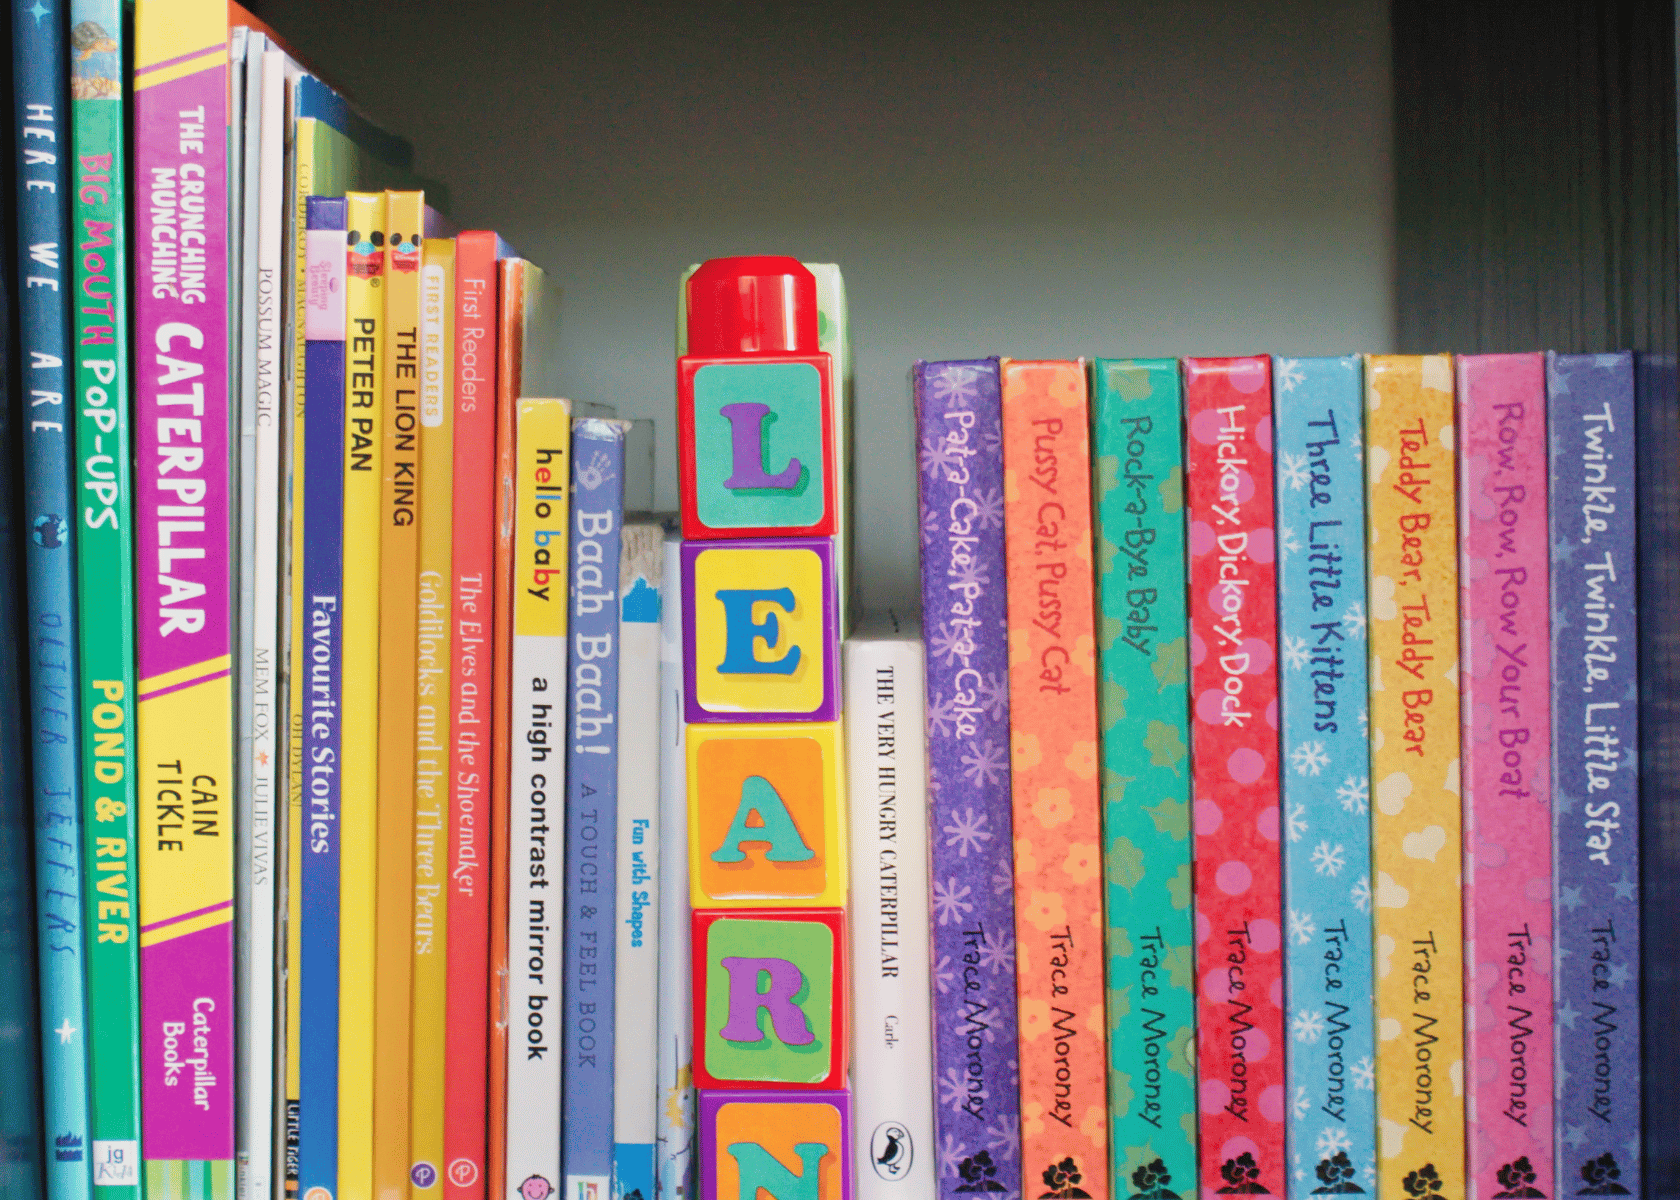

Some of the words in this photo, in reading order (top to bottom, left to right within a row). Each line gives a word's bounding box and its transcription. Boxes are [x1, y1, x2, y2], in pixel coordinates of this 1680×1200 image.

[24, 104, 56, 194] HERE
[179, 106, 205, 154] THE
[79, 152, 113, 206] BIG
[26, 241, 59, 292] WE
[151, 168, 179, 299] MUNCHING
[180, 163, 206, 304] CRUNCHING
[257, 268, 274, 350] POSSUM
[307, 265, 319, 306] Beauty
[317, 261, 333, 310] Sleeping
[425, 275, 441, 324] FIRST
[461, 279, 486, 319] First
[352, 318, 374, 408] PETER
[396, 327, 417, 378] THE
[424, 330, 442, 417] READERS
[460, 327, 486, 412] Readers
[29, 351, 64, 433] ARE
[257, 359, 273, 427] MAGIC
[394, 389, 416, 452] LION
[350, 417, 373, 472] PAN
[1029, 418, 1064, 494] Pussy
[1212, 404, 1248, 526] Hickory,
[1306, 409, 1340, 509] Three
[1393, 418, 1431, 504] Teddy
[1493, 402, 1525, 477] Row,
[1581, 402, 1616, 544] Twinkle,
[156, 322, 206, 637] CATERPILLAR
[392, 463, 415, 527] KING
[535, 449, 562, 518] hello
[1119, 415, 1156, 581] Rock-a-Bye
[1034, 502, 1066, 556] Cat,
[1399, 513, 1431, 587] Bear,
[1493, 485, 1527, 559] Row,
[459, 573, 482, 613] The
[528, 530, 561, 602] baby
[576, 509, 614, 616] Baah
[1213, 532, 1249, 646] Dickory,
[1309, 520, 1342, 612] Little
[418, 570, 444, 696] Goldilocks
[1033, 562, 1069, 638] Pussy
[1121, 587, 1158, 656] Baby
[1396, 594, 1433, 680] Teddy
[1495, 567, 1528, 636] Row
[1582, 551, 1618, 693] Twinkle,
[36, 611, 69, 744] OLIVER
[254, 648, 270, 697] MEM
[311, 594, 336, 739] Favourite
[459, 620, 484, 677] Elves
[532, 677, 549, 692] a
[876, 666, 895, 705] THE
[948, 582, 983, 740] Pat-a-Cake
[1039, 646, 1071, 695] Cat
[1310, 621, 1345, 734] Kittens
[1496, 643, 1529, 718] Your
[254, 703, 269, 741] FOX
[458, 682, 480, 724] and
[575, 632, 613, 754] Baah!
[1219, 653, 1252, 728] Dock
[1402, 689, 1433, 757] Bear
[92, 680, 125, 783] POND
[418, 705, 443, 751] and
[457, 732, 480, 765] the
[527, 704, 553, 762] high
[877, 711, 895, 760] VERY
[1498, 728, 1531, 800] Boat
[1585, 702, 1620, 794] Little
[95, 797, 127, 823] &
[157, 760, 183, 852] TICKLE
[192, 775, 220, 836] CAIN
[253, 775, 268, 827] JULIE
[311, 746, 335, 854] Stories
[417, 759, 442, 799] the
[581, 783, 597, 798] A
[878, 767, 898, 844] HUNGRY
[254, 832, 268, 886] VIVAS
[416, 804, 442, 878] Three
[453, 772, 480, 897] Shoemaker
[529, 773, 549, 888] contrast
[580, 809, 598, 895] TOUCH
[631, 819, 649, 845] Fun
[1585, 802, 1621, 865] Star
[43, 787, 76, 956] JEFFERS
[96, 837, 130, 944] RIVER
[631, 851, 650, 885] with
[415, 883, 441, 955] Bears
[528, 900, 549, 984] mirror
[579, 905, 597, 920] &
[626, 891, 650, 948] Shapes
[879, 849, 899, 978] CATERPILLAR
[580, 931, 597, 992] FEEL
[962, 921, 987, 995] Trace
[1050, 925, 1074, 998] Trace
[1140, 926, 1164, 999] Trace
[1227, 921, 1252, 993] Trace
[1324, 919, 1347, 993] Trace
[1413, 931, 1437, 1004] Trace
[1508, 923, 1531, 997] Trace
[1591, 919, 1616, 992] Trace
[162, 1021, 185, 1087] Books
[188, 997, 216, 1110] Caterpillar
[528, 995, 548, 1061] book
[578, 1003, 596, 1069] BOOK
[884, 1014, 899, 1049] Carle
[960, 999, 989, 1122] Moroney
[1225, 999, 1253, 1123] Moroney
[1321, 1000, 1350, 1123] Moroney
[1588, 1001, 1618, 1124] Moroney
[1049, 1007, 1077, 1128] Moroney
[1139, 1007, 1167, 1129] Moroney
[1410, 1013, 1439, 1135] Moroney
[1504, 1005, 1533, 1127] Moroney
